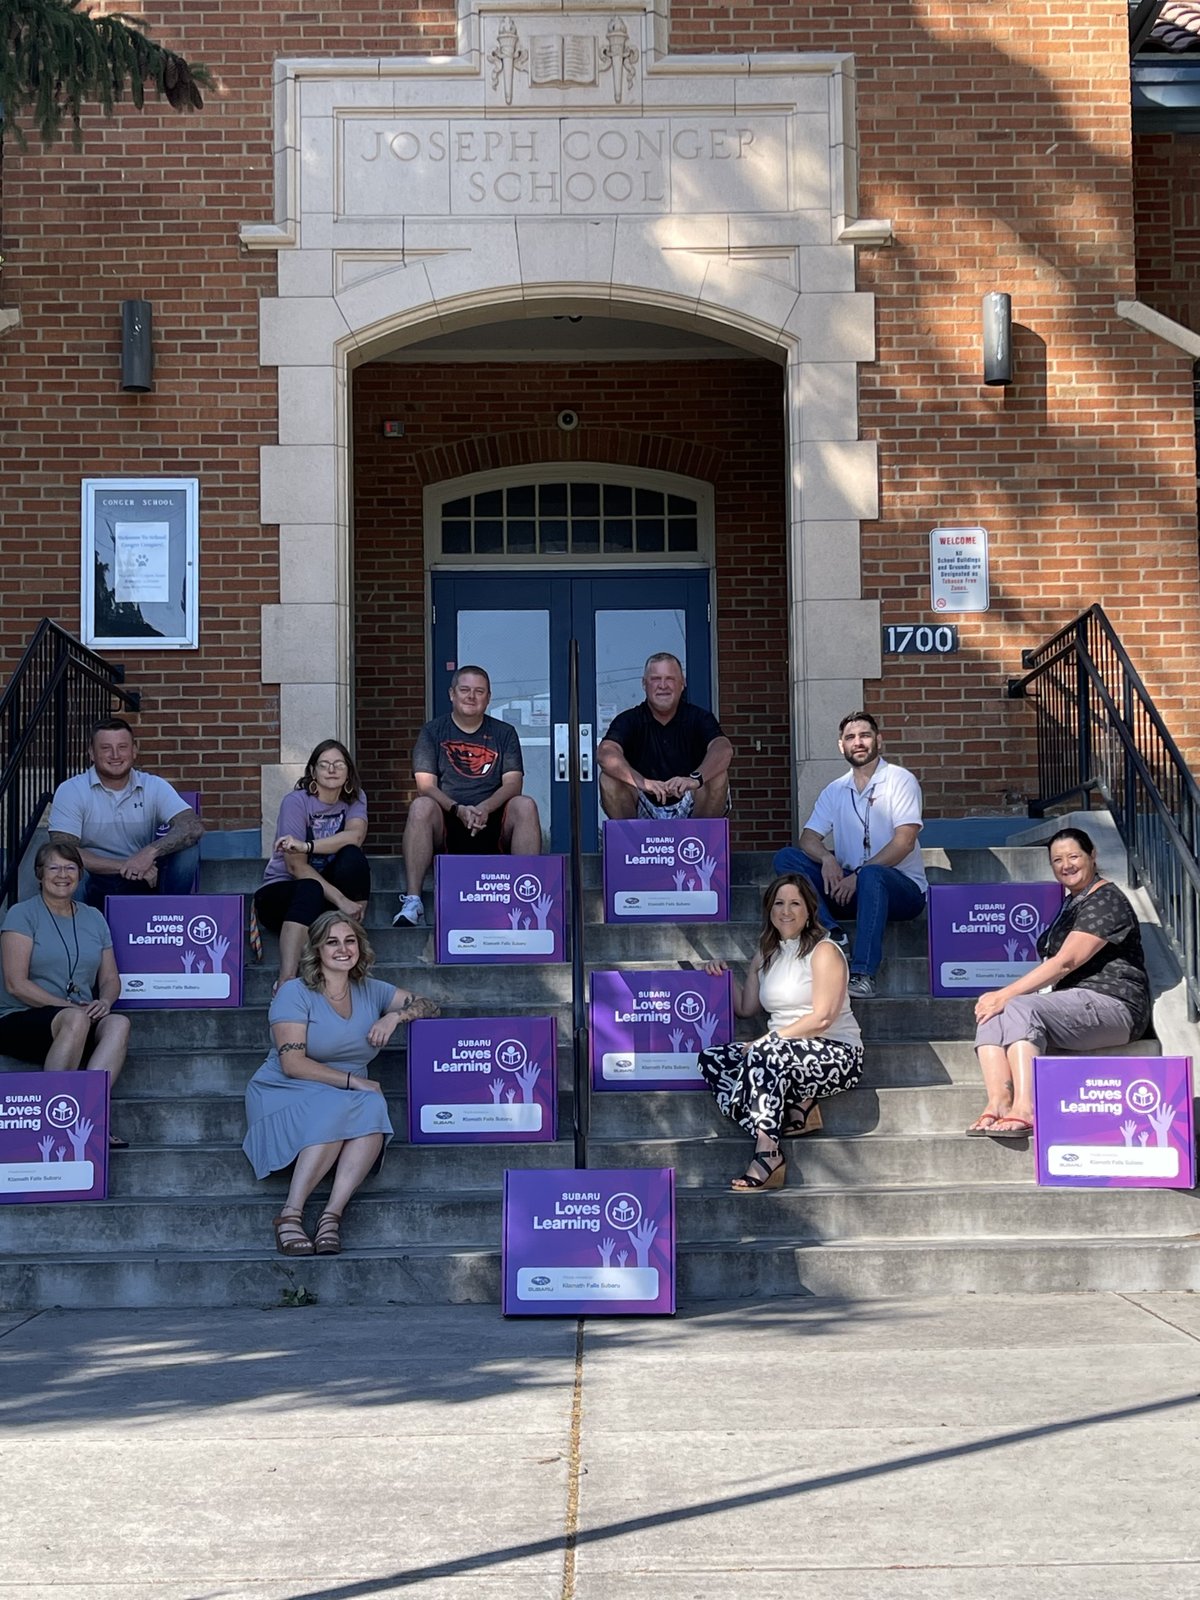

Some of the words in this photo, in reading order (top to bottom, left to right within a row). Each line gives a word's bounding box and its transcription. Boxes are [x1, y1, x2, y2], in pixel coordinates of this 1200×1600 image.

[361, 129, 538, 162] JOSEPH
[562, 128, 763, 161] CONGER
[468, 171, 665, 203] SCHOOL
[940, 536, 976, 545] WELCOME
[888, 626, 952, 652] 1700
[641, 844, 674, 854] Loves
[625, 855, 674, 866] Learning
[476, 881, 510, 891] Loves
[460, 891, 510, 903] Learning
[969, 911, 1006, 921] Loves
[146, 922, 184, 933] Loves
[952, 922, 1006, 934] Learning
[129, 934, 184, 946] Learning
[632, 999, 671, 1010] Loves
[615, 1011, 671, 1024] Learning
[452, 1048, 491, 1059] Loves
[434, 1060, 491, 1074] Learning
[1080, 1087, 1122, 1100] Loves
[0, 1104, 41, 1116] Loves
[1060, 1100, 1122, 1116] Learning
[562, 1192, 600, 1200] SUBARU
[555, 1202, 600, 1215] Loves
[534, 1216, 600, 1232] Learning
